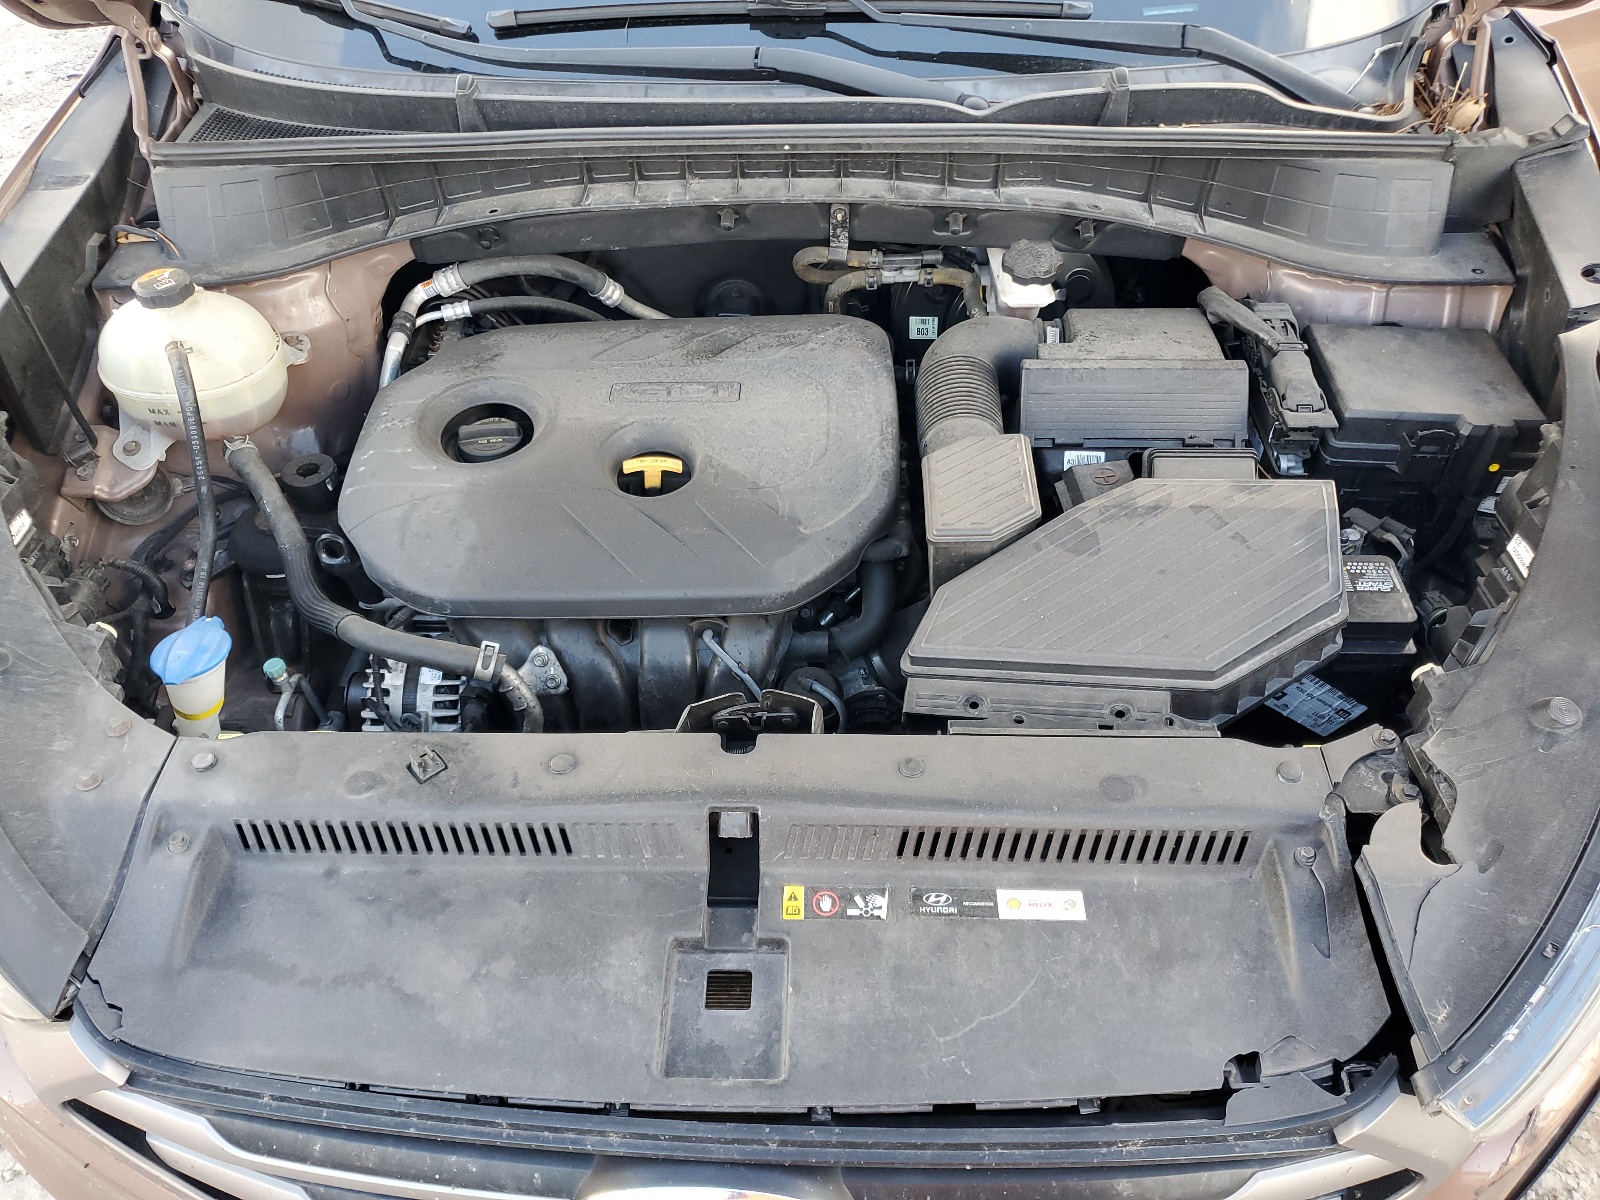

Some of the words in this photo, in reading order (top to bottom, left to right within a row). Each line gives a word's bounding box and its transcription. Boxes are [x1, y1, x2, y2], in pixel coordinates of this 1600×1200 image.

[147, 407, 170, 416] MAX
[154, 419, 177, 427] MIN
[919, 906, 958, 915] HYUNDAI
